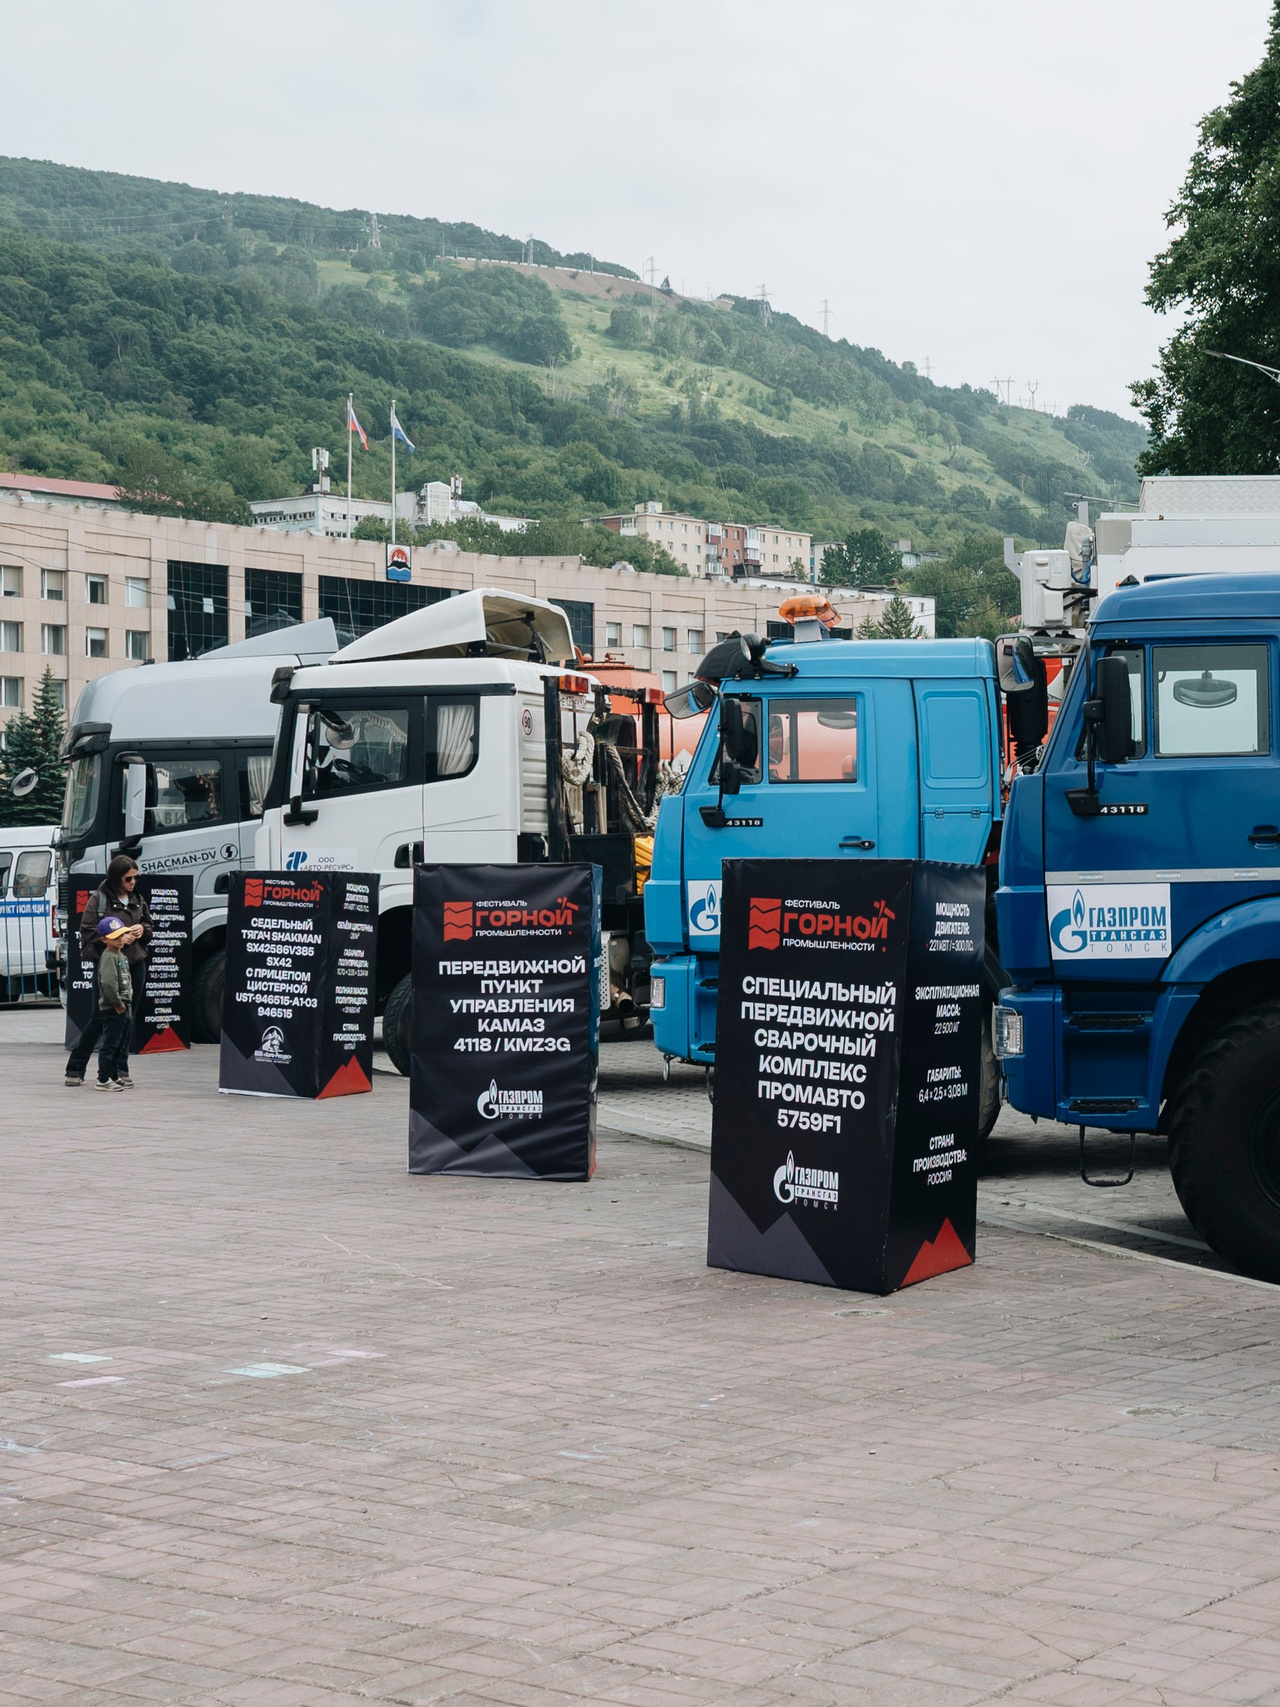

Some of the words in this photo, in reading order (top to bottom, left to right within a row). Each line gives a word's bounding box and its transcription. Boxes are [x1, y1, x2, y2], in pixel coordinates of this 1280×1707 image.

[142, 850, 216, 872] SHACMAN-DV
[264, 882, 322, 902] ГОРНОЙ
[785, 899, 840, 909] ФЕСТИВАЛЬ
[936, 902, 970, 918] МОЩНОСТЬ
[476, 898, 577, 927] ГОРНОЙ
[1089, 906, 1166, 928] ГАЗПРОМ
[251, 918, 313, 930] СЕДЕЛЬНЫЙ
[783, 902, 894, 940] ГОРНОЙ
[476, 929, 562, 937] ПРОМЫШЛЕННОСТИ
[935, 922, 970, 936] ДВИГАТЕЛЯ:
[1092, 931, 1166, 941] ТРАНСГАЗ
[241, 930, 270, 940] ТЯГАЧ
[272, 932, 322, 944] SHAKMAN
[783, 938, 875, 951] ПРОМЫШЛЕННОСТИ
[246, 942, 314, 956] SX42586V385
[1090, 942, 1168, 953] ТОМСК
[266, 956, 292, 967] SX42
[439, 956, 586, 976] ПЕРЕДВИЖНОЙ
[246, 968, 253, 977] С
[254, 968, 310, 981] ПРИЦЕПОМ
[247, 980, 308, 994] ЦИСТЕРНОЙ
[481, 979, 543, 994] ПУНКТ
[742, 976, 896, 1005] СПЕЦИАЛЬНЫЙ
[915, 984, 980, 1000] ЭКСПЛУАТАЦИОННАЯ
[258, 1007, 292, 1018] 946515
[450, 998, 574, 1013] УПРАВЛЕНИЯ
[936, 1004, 960, 1017] МАССА:
[741, 1002, 894, 1032] ПЕРЕДВИЖНОЙ
[478, 1018, 545, 1032] КАМАЗ
[454, 1038, 492, 1052] 4118
[494, 1038, 500, 1052] /
[504, 1038, 571, 1052] KMZ3G
[754, 1029, 876, 1057] СВАРОЧНЫЙ
[759, 1055, 867, 1083] КОМПЛЕКС
[927, 1066, 961, 1082] ГАБАРИТЫ:
[498, 1090, 542, 1104] ГАЗПРОМ
[758, 1080, 865, 1110] ПРОМАВТО
[919, 1089, 928, 1104] 6,4
[934, 1087, 943, 1101] 2,5
[948, 1084, 961, 1099] 3,08
[962, 1083, 968, 1096] М
[777, 1109, 841, 1134] 5759F1
[929, 1134, 954, 1150] СТРАНА
[913, 1149, 967, 1172] ПРОИЗВОДСТВА:
[795, 1167, 838, 1190] ГАЗПРОМ
[927, 1170, 952, 1186] РОССИЯ
[796, 1188, 837, 1200] ТРАНСГАЗ
[794, 1198, 838, 1210] ТОМСК
